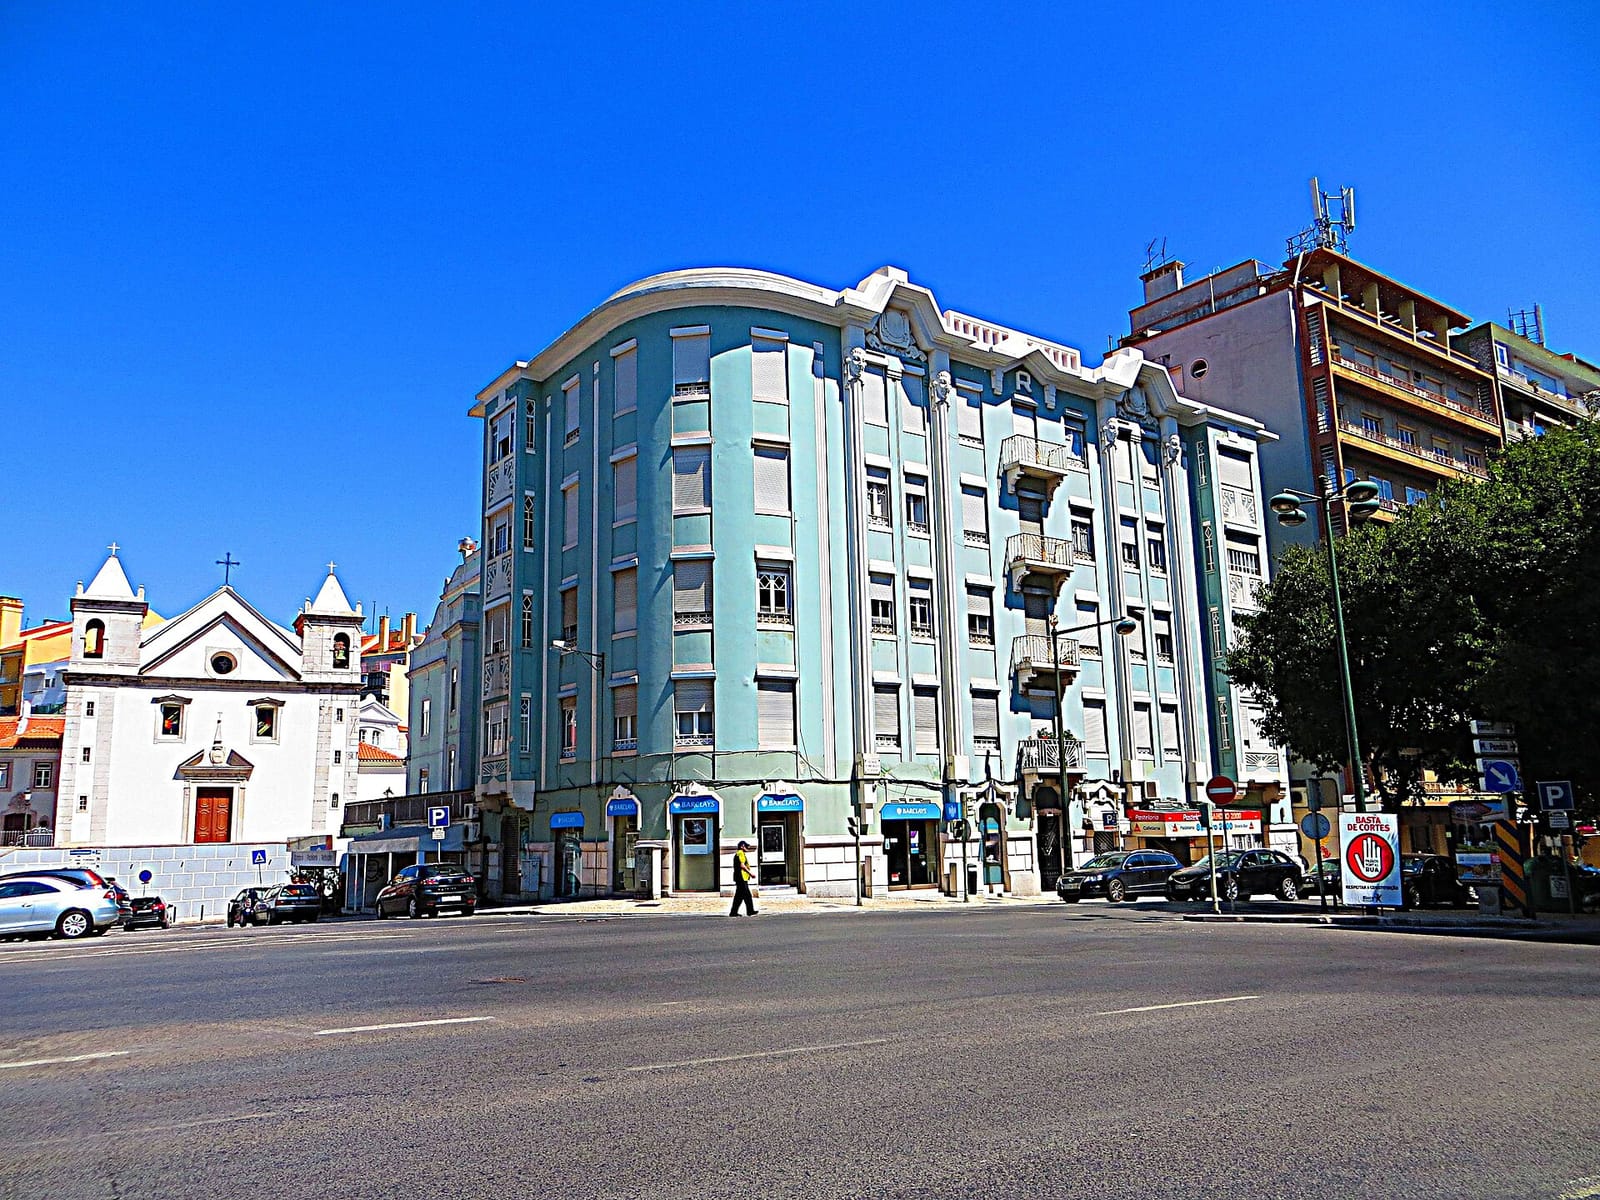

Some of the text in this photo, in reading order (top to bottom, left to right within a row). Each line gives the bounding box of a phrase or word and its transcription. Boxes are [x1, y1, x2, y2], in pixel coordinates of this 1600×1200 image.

[1015, 370, 1033, 393] R
[1546, 786, 1565, 806] P
[681, 801, 716, 809] BARCLAYS
[432, 809, 446, 826] P
[1355, 816, 1382, 824] BASTA
[1347, 823, 1391, 832] DE CORTES
